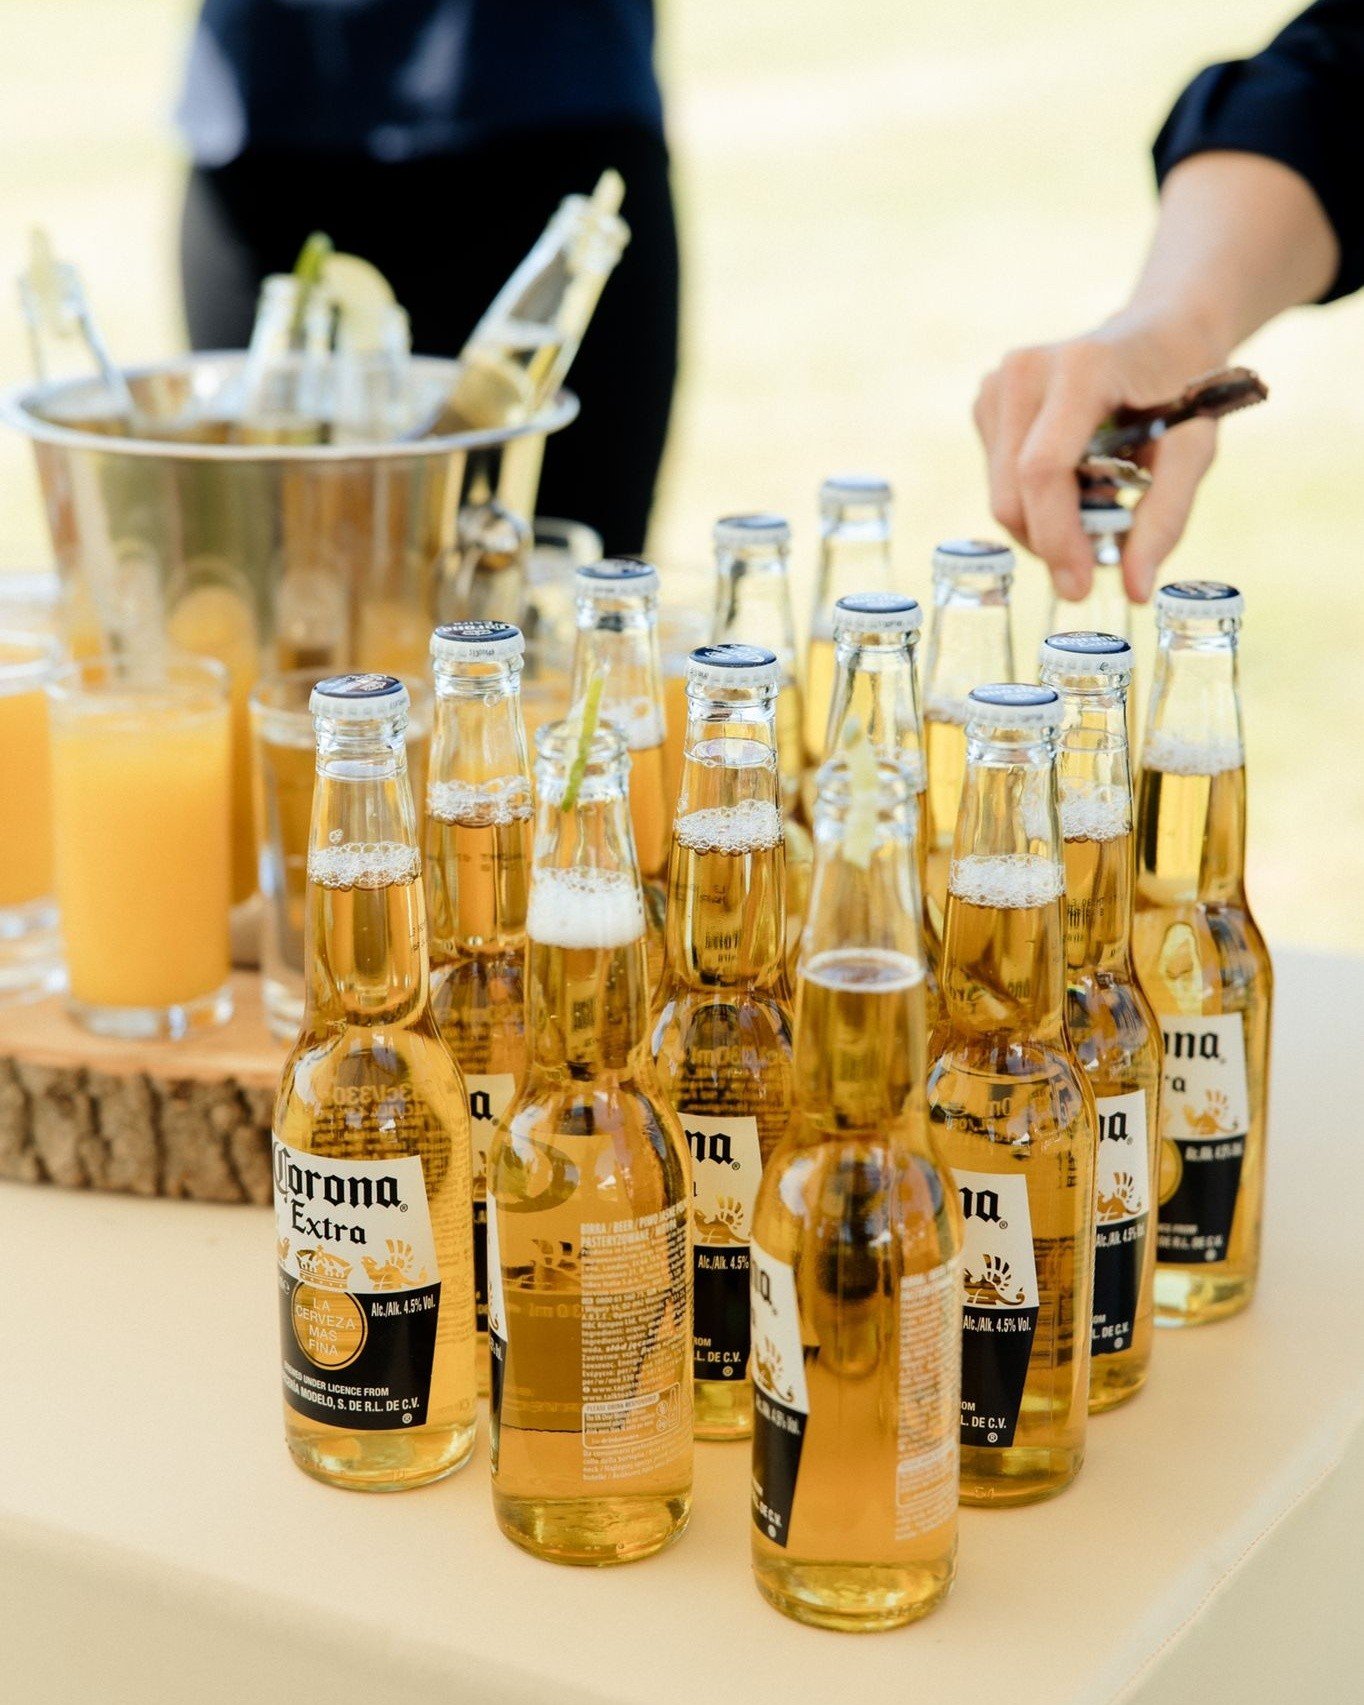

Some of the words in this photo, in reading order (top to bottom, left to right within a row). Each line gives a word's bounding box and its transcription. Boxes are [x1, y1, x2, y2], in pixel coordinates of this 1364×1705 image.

[273, 1141, 402, 1208] Corona
[291, 1199, 367, 1244] Extra
[313, 1297, 331, 1312] LA
[371, 1302, 401, 1318] Alc./Alk.
[403, 1297, 422, 1315] 4.5%
[423, 1294, 436, 1310] Vol.
[296, 1305, 356, 1330] CERVEZA
[963, 1314, 994, 1333] Alc./Alk.
[996, 1317, 1016, 1332] 4.5%
[1018, 1316, 1031, 1331] Vol.
[309, 1324, 337, 1342] MAS
[308, 1339, 339, 1356] FINA
[708, 1351, 721, 1362] DE
[723, 1351, 741, 1362] C.V.
[303, 1374, 326, 1391] UNDER
[328, 1382, 361, 1396] LICENCE
[364, 1387, 389, 1397] FROM
[300, 1385, 335, 1410] MODELO,
[337, 1398, 346, 1410] S.
[349, 1400, 362, 1411] DE
[365, 1401, 383, 1412] R.L.
[386, 1400, 399, 1411] DE
[402, 1397, 420, 1411] C.V.
[972, 1416, 985, 1428] DE
[988, 1417, 1007, 1429] C.V.
